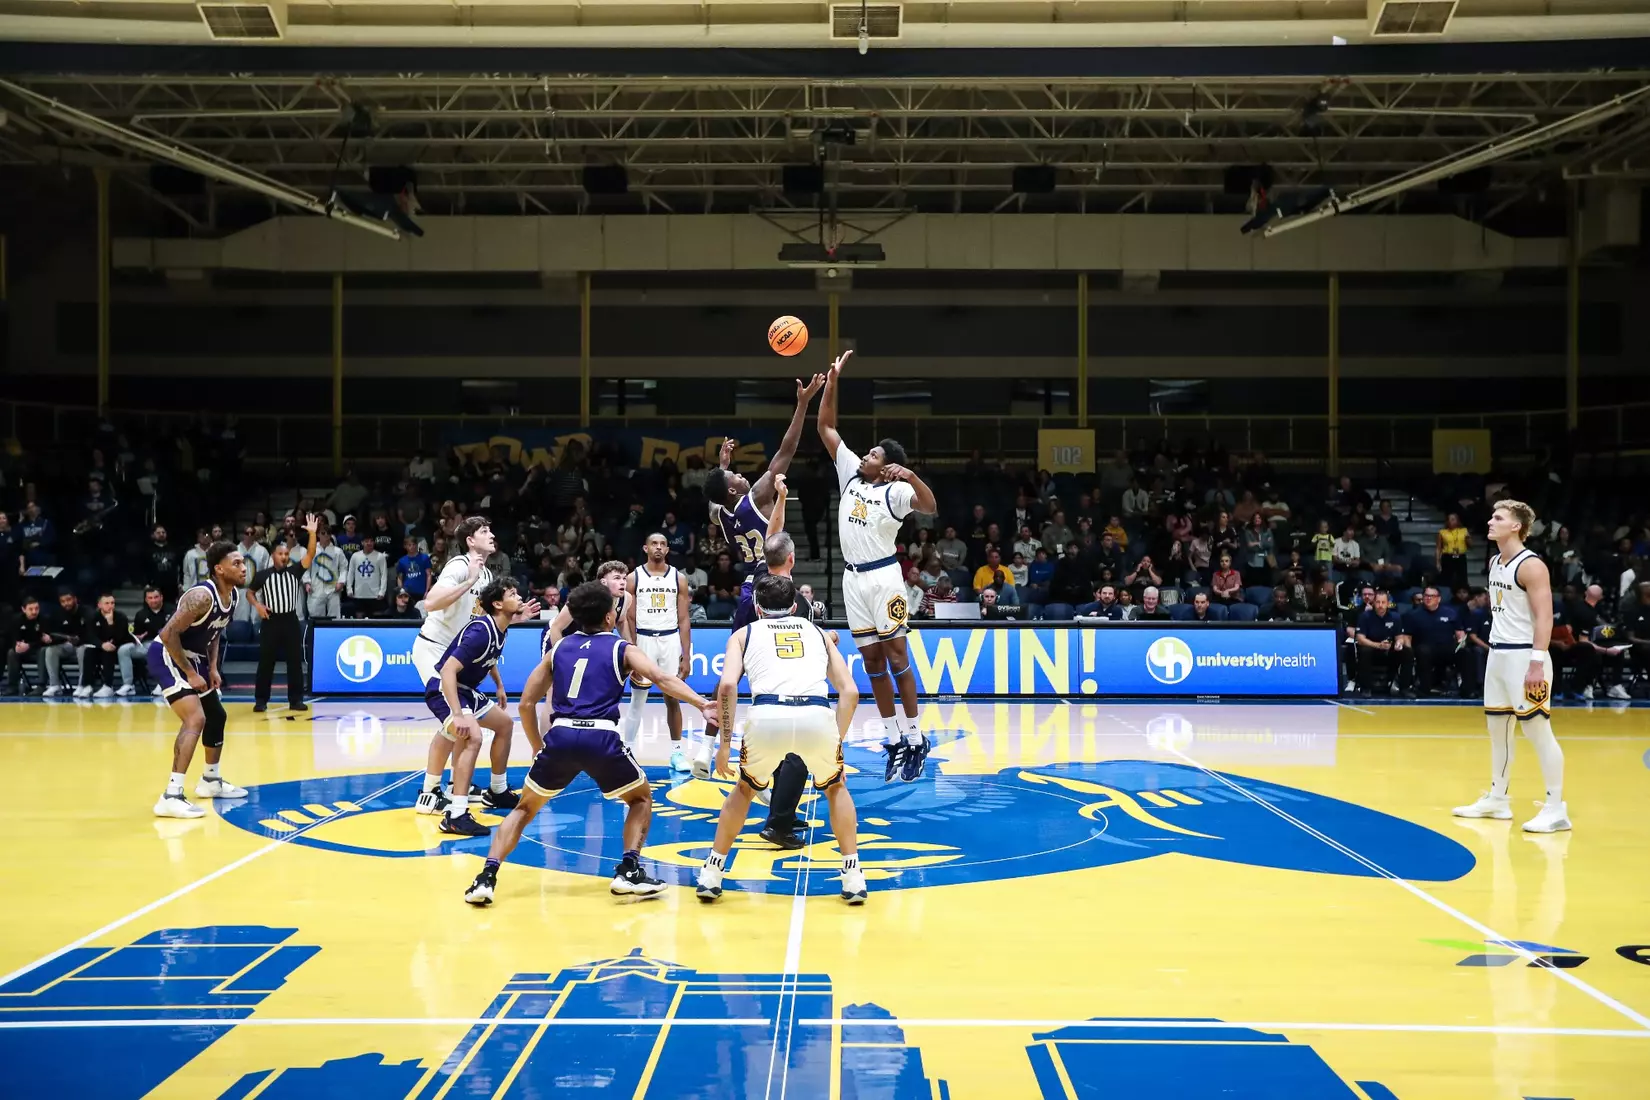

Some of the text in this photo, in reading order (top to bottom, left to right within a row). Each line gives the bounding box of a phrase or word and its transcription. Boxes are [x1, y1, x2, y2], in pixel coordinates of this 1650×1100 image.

[777, 331, 793, 346] NCAA
[1051, 446, 1082, 465] 102
[849, 489, 881, 506] KANSAS
[849, 516, 867, 527] CITY
[1489, 580, 1513, 591] KANSAS
[651, 593, 666, 608] 13
[774, 632, 804, 659] 5
[908, 629, 1098, 694] WIN!
[1196, 652, 1316, 670] universityhealth
[567, 658, 588, 698] 1
